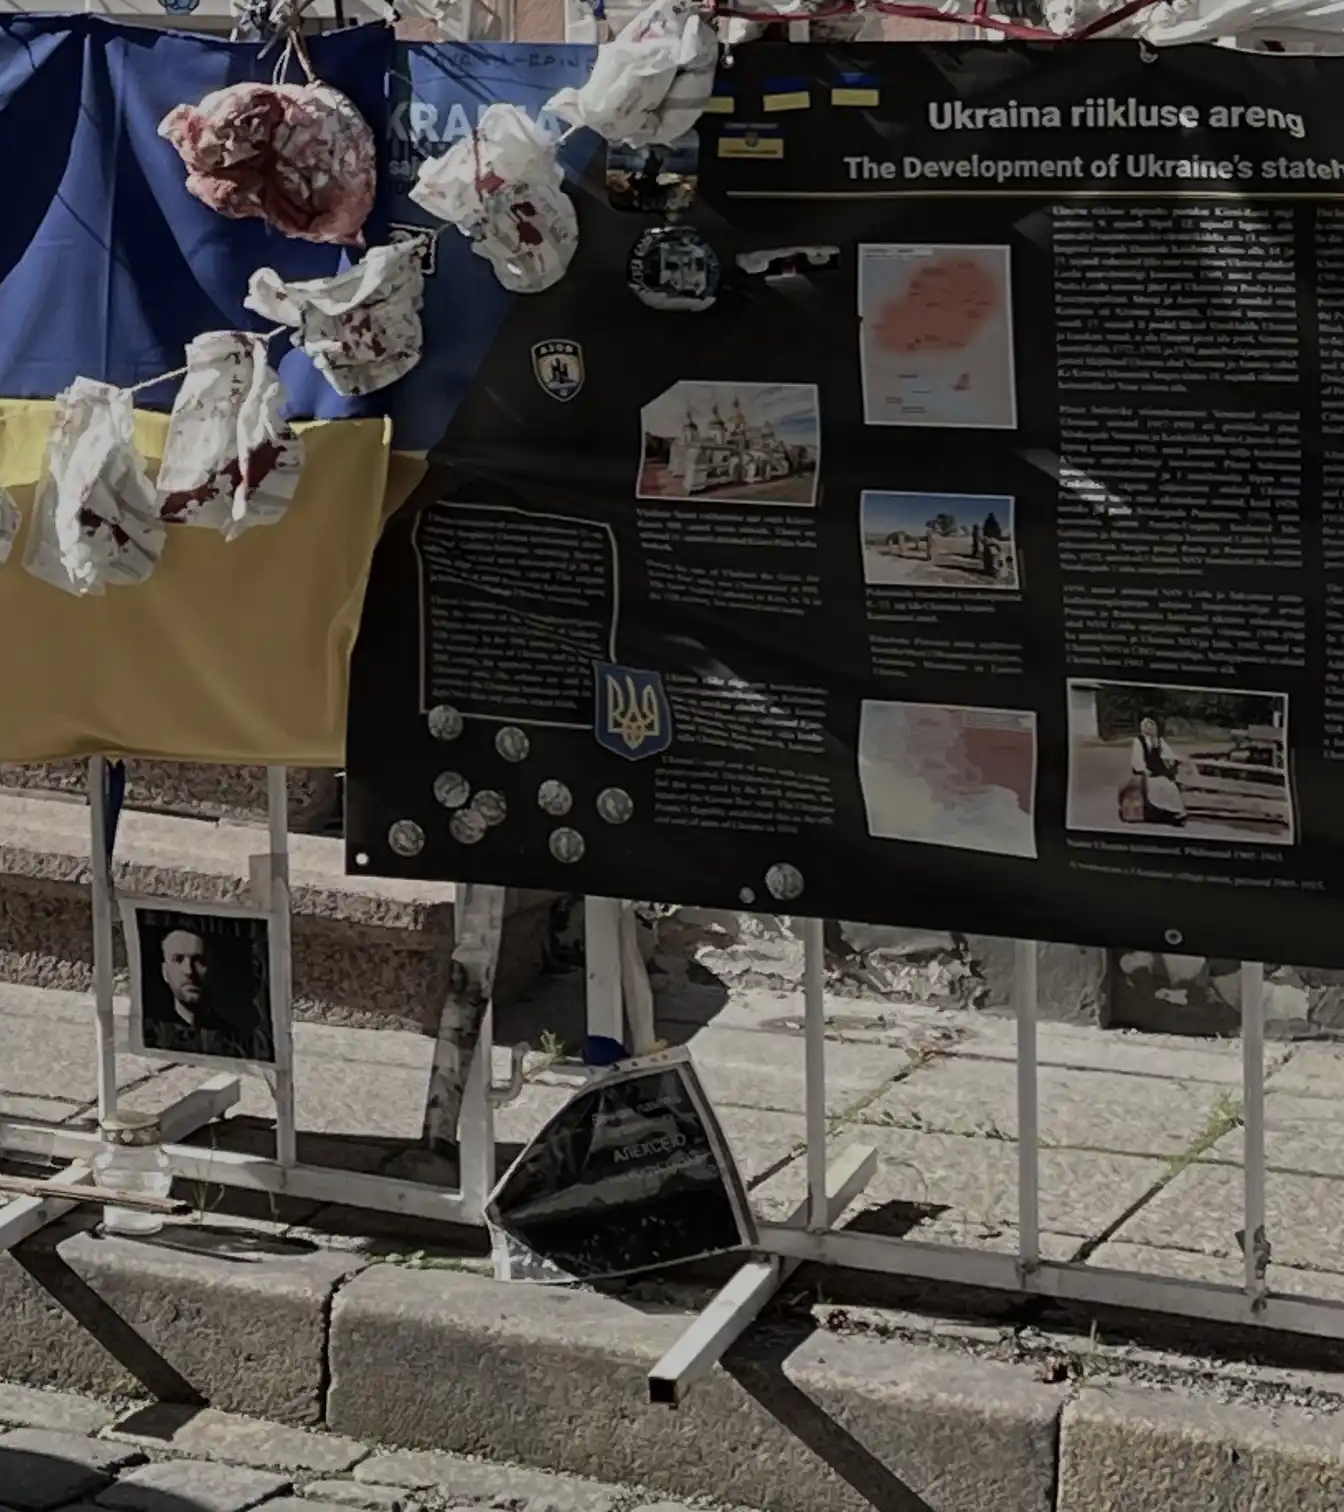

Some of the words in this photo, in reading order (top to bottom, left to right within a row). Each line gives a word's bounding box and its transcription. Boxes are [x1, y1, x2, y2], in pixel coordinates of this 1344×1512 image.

[927, 99, 1062, 131] Ukraina
[1070, 96, 1201, 129] riikluse
[1208, 104, 1308, 139] areng
[842, 155, 897, 180] The
[902, 153, 1085, 184] Development
[1089, 152, 1121, 179] of
[1126, 152, 1254, 180] Ukraine's
